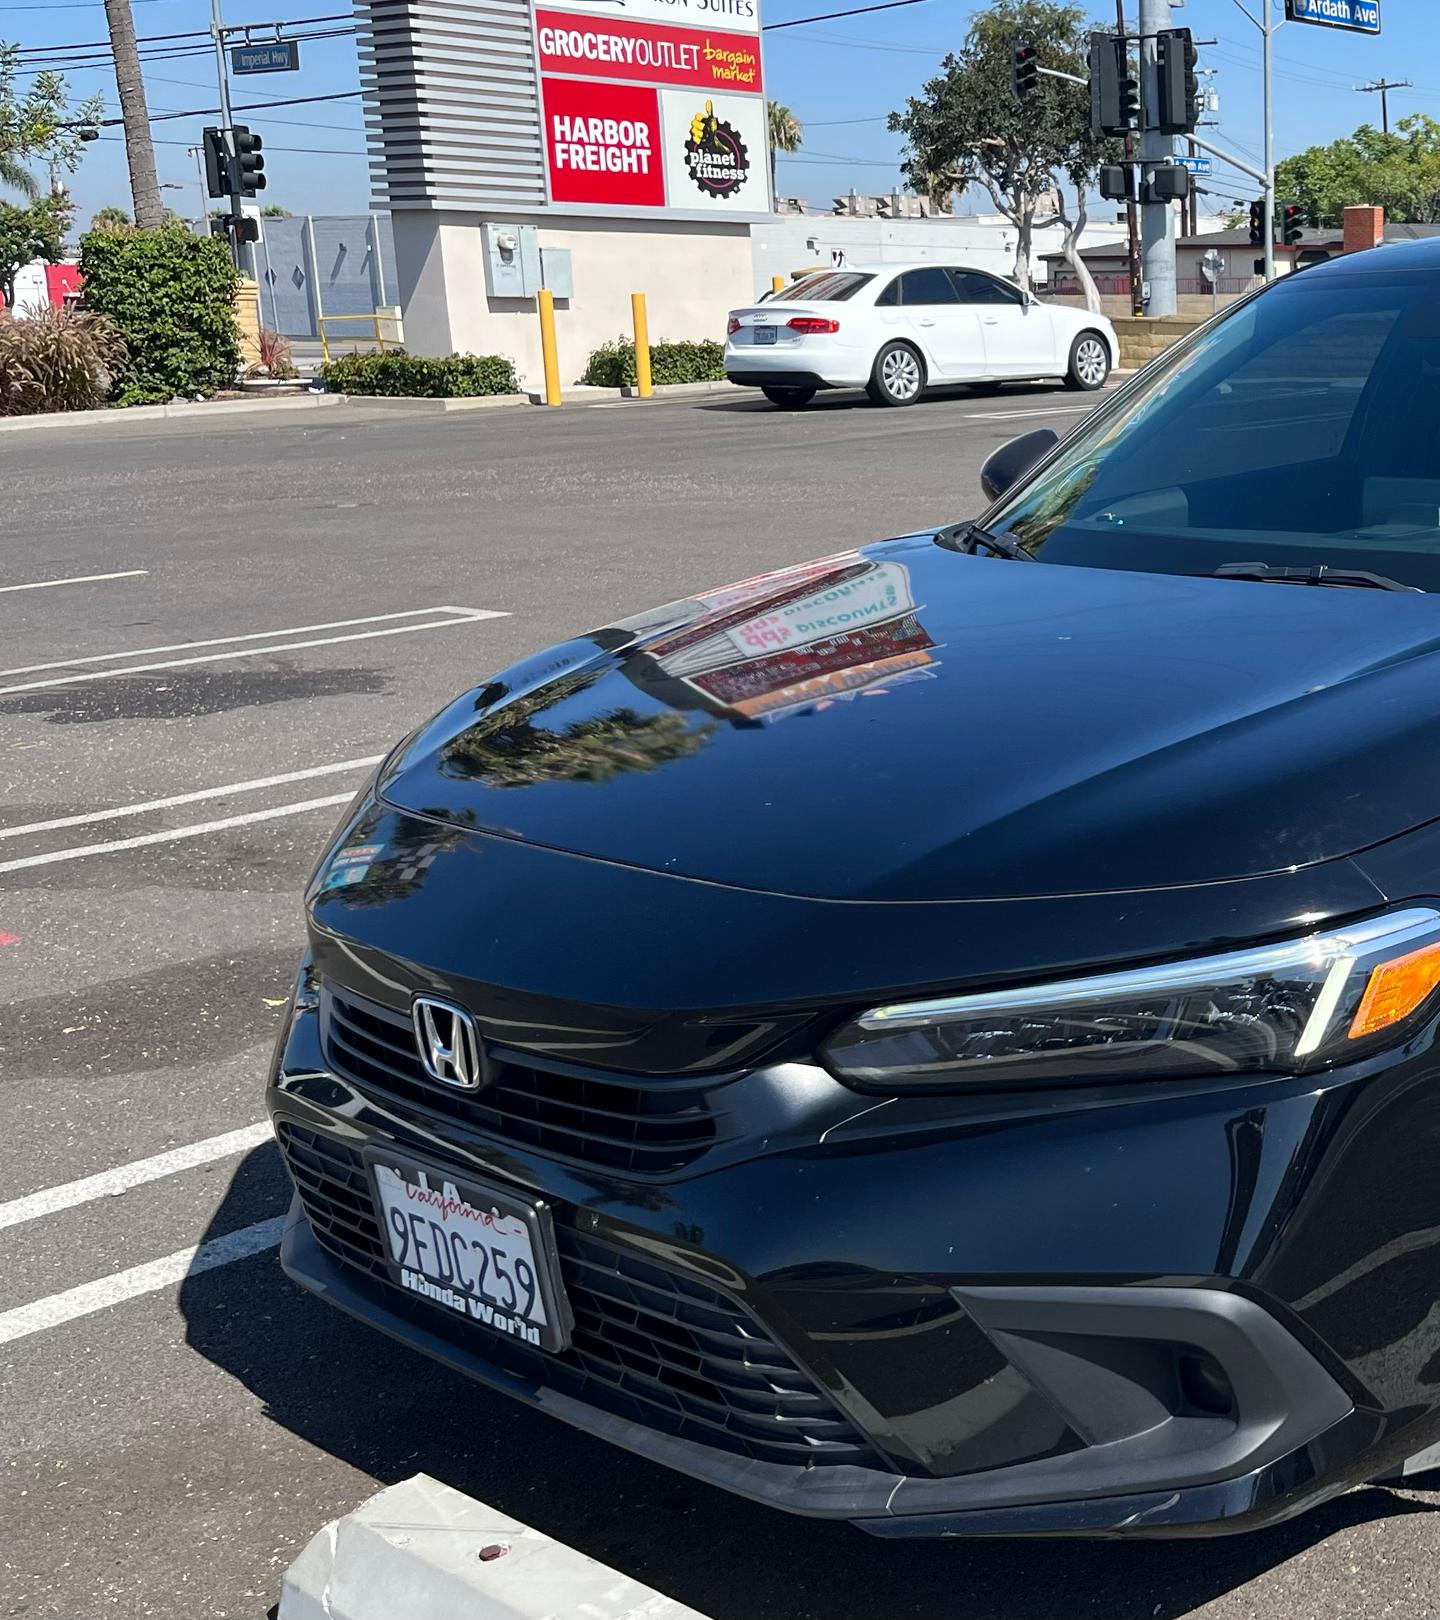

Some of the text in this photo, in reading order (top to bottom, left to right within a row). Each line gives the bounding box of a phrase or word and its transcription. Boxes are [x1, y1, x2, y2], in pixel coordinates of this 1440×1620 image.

[1308, 0, 1377, 24] Ardath Ave
[241, 50, 289, 69] Imperial Hwy
[703, 39, 755, 69] bargain
[712, 64, 755, 83] market
[553, 115, 649, 148] HARBOR
[555, 143, 651, 174] FREIGHT
[690, 149, 735, 167] planet
[697, 163, 745, 180] fitness
[390, 1206, 535, 1318] 9FDC259
[401, 1268, 540, 1346] Honda World
